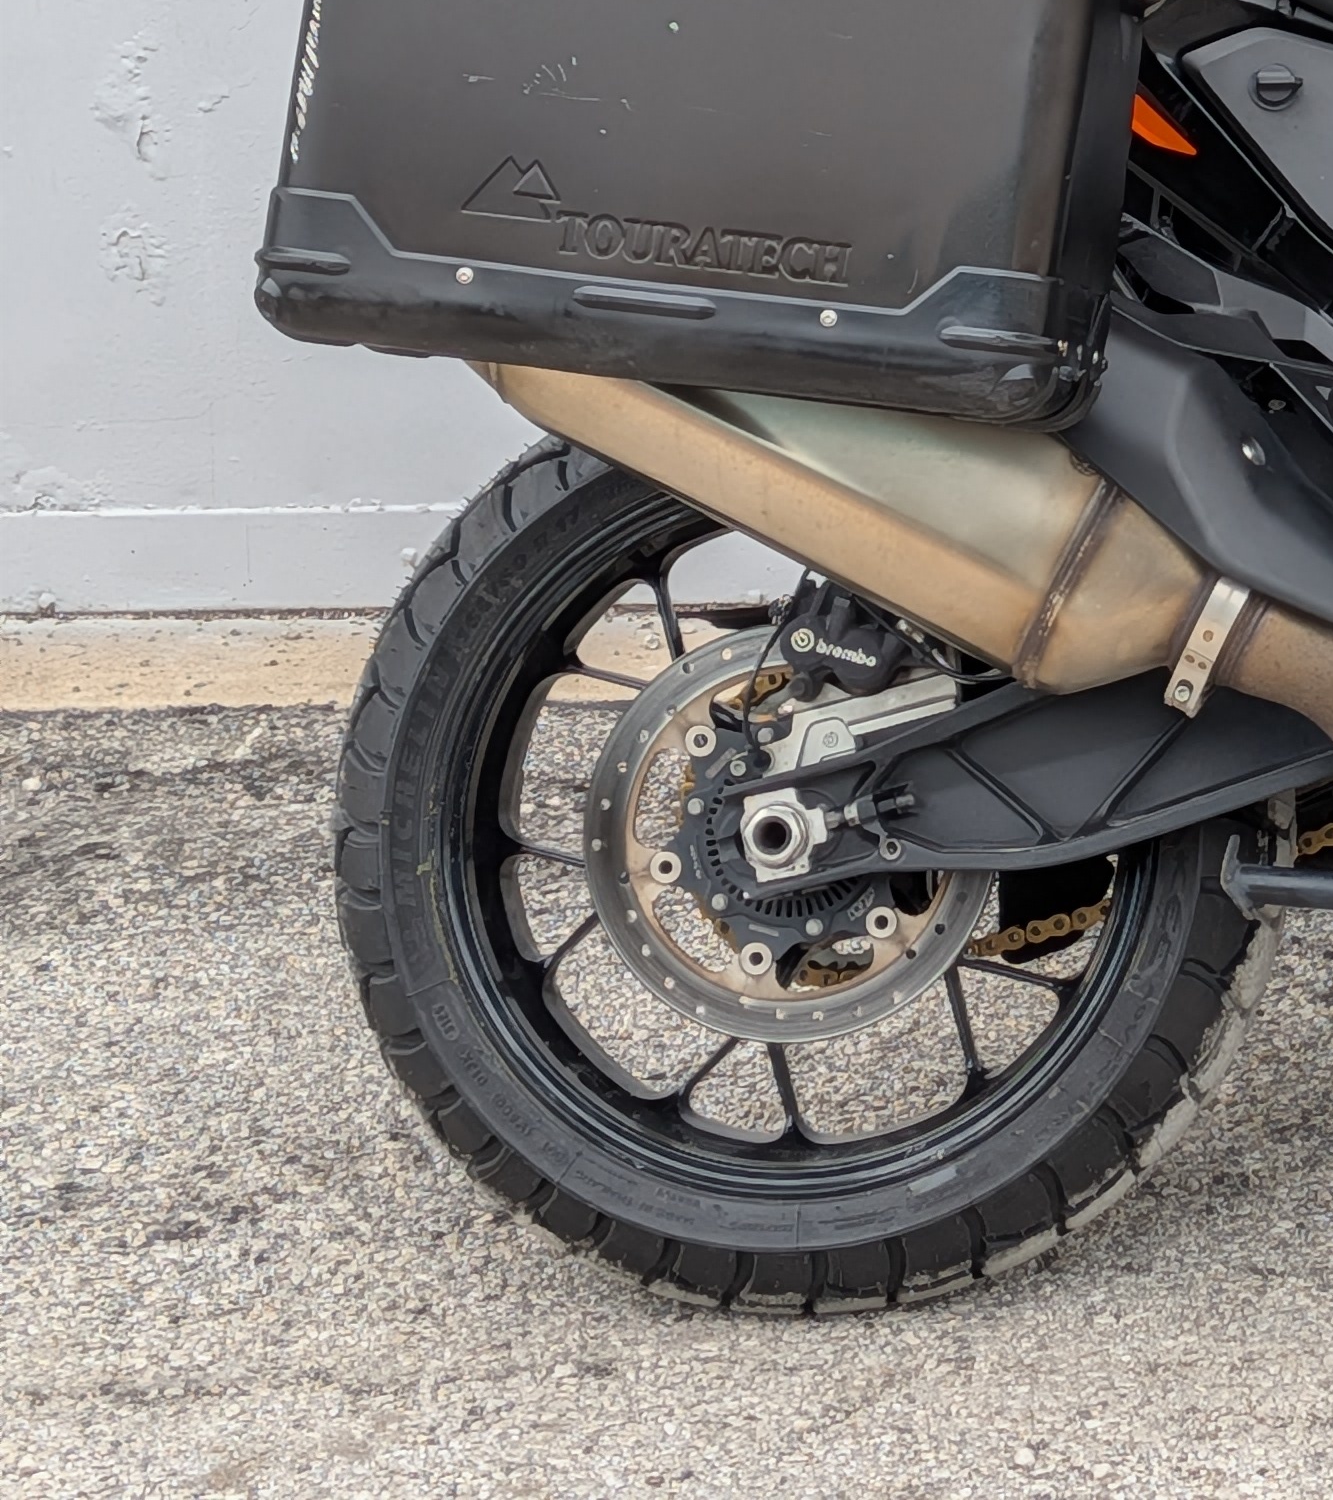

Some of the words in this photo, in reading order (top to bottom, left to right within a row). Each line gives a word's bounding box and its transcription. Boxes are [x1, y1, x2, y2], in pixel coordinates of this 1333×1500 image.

[555, 209, 854, 288] TOURATECH
[815, 638, 877, 668] brembo
[391, 660, 456, 907] MICHELIN
